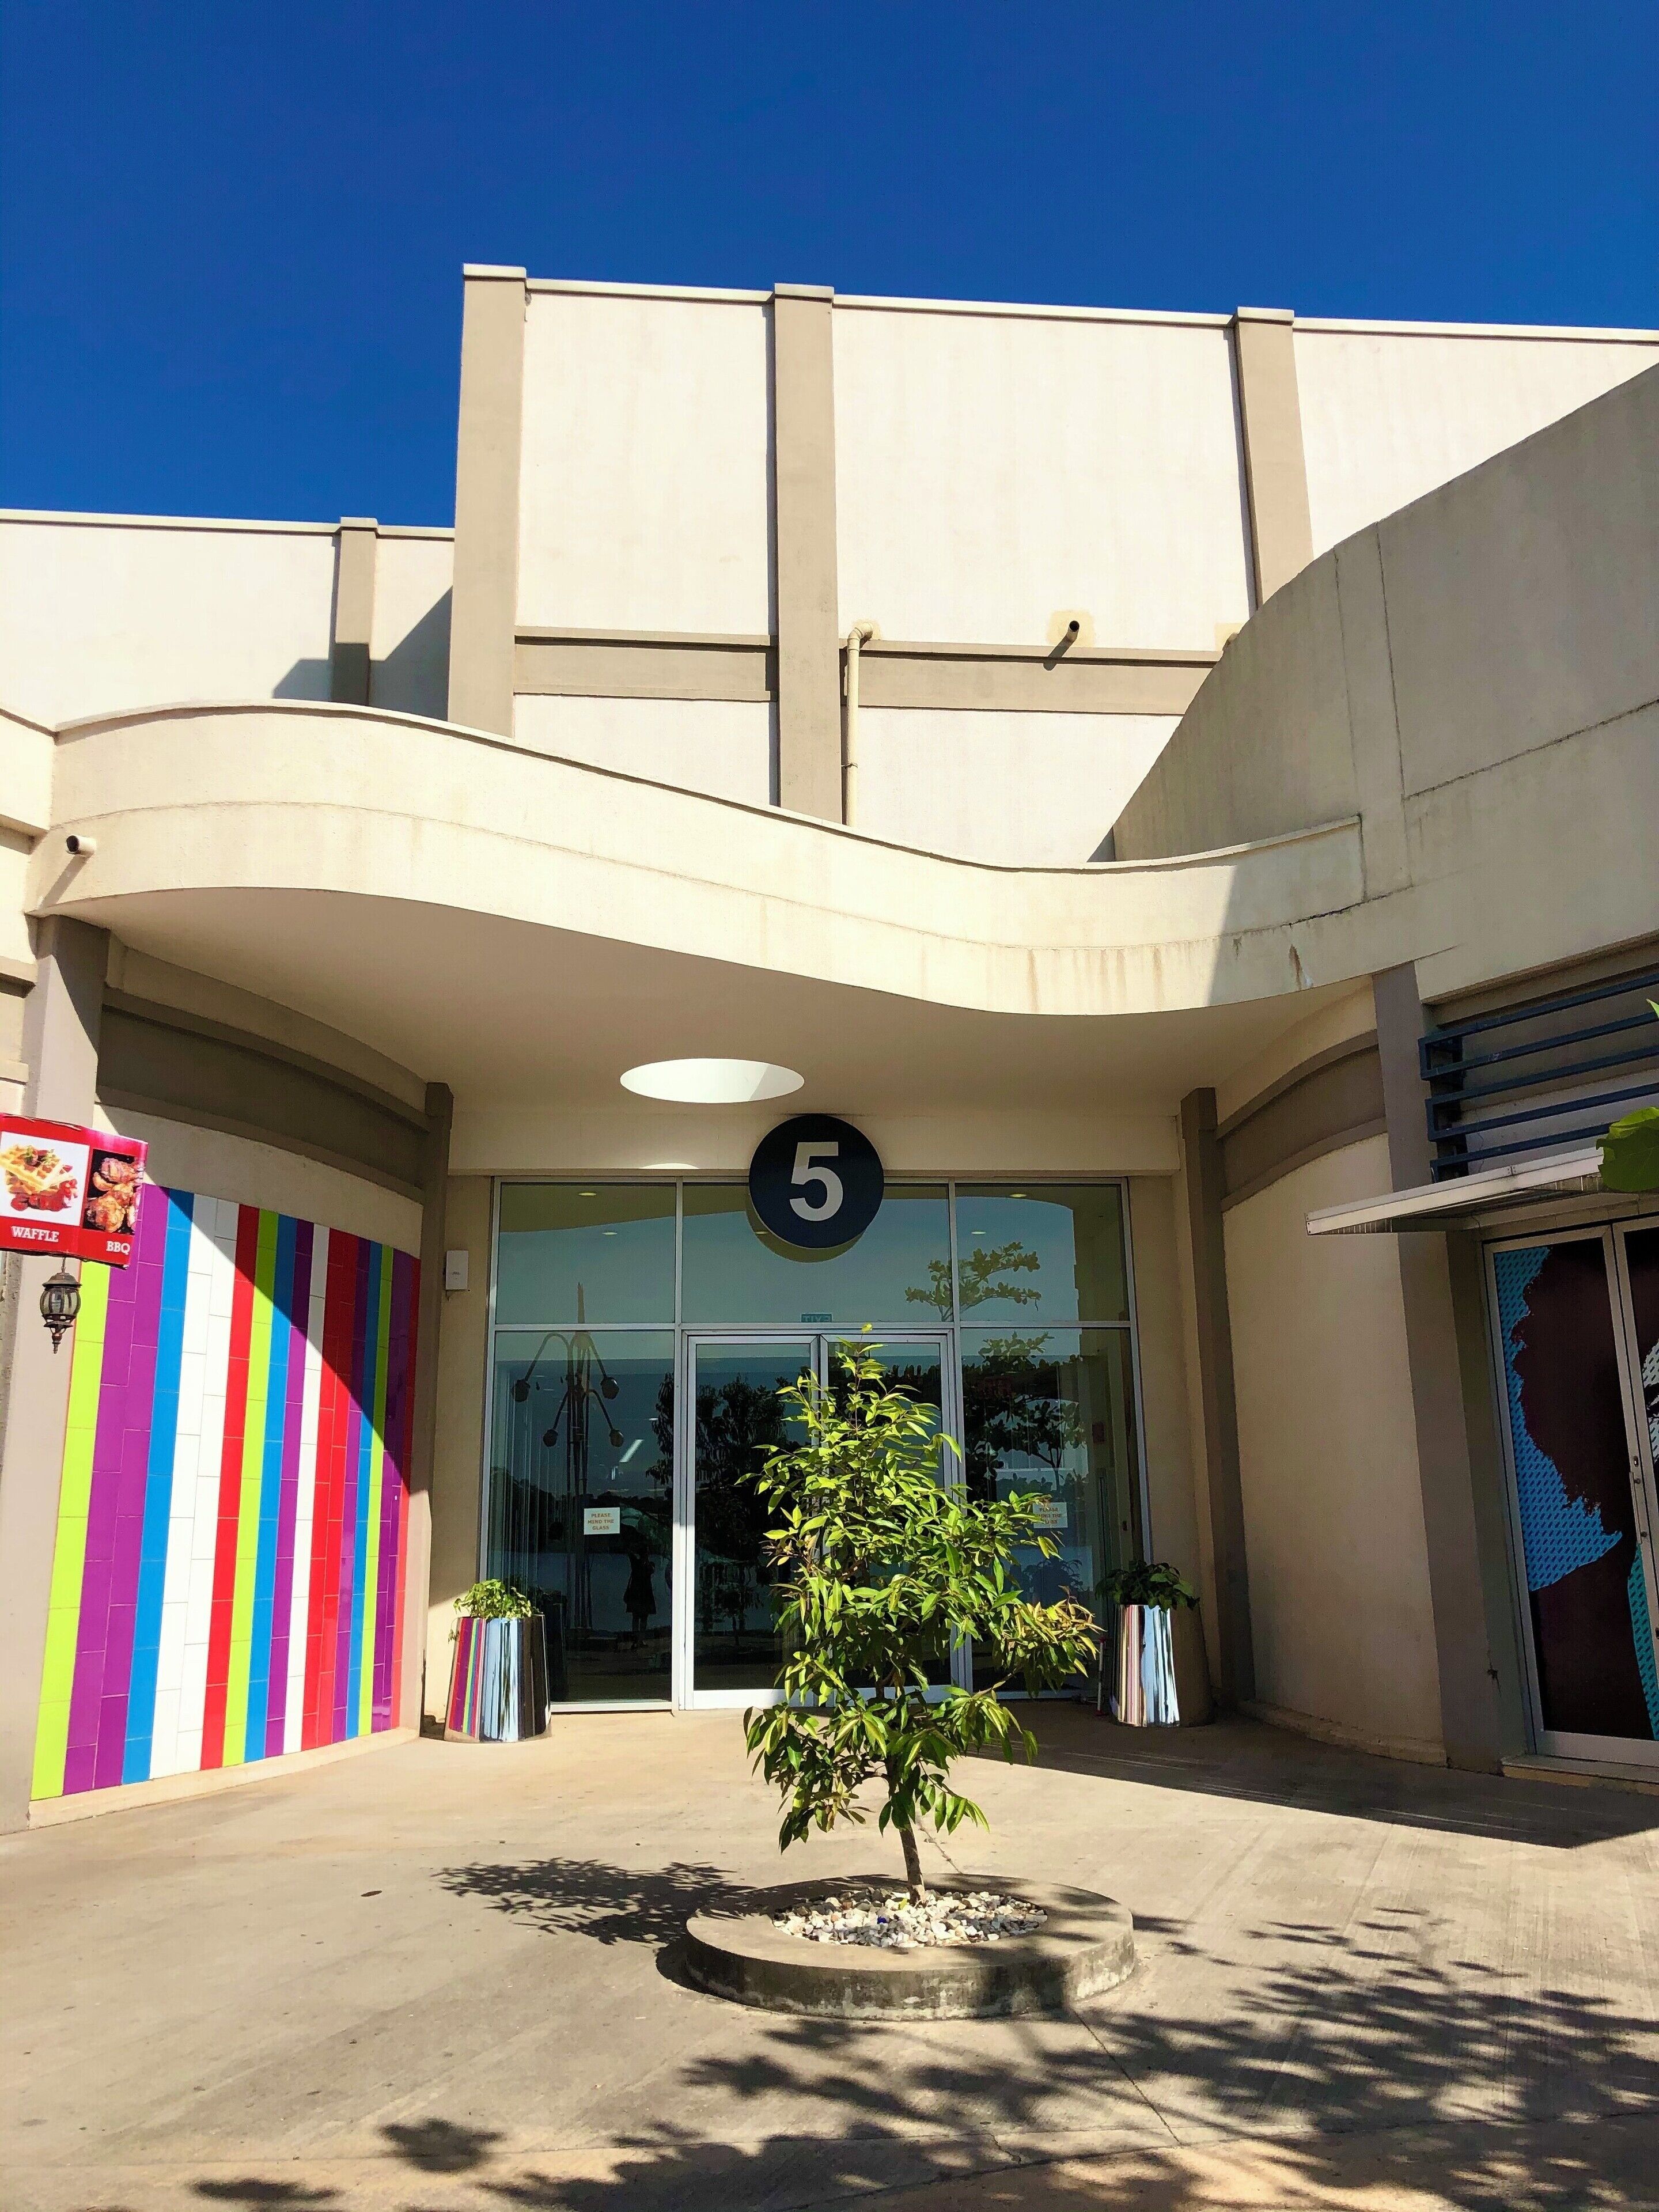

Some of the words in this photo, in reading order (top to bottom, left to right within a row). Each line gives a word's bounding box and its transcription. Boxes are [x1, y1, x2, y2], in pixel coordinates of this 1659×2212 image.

[789, 1141, 843, 1221] 5
[11, 1226, 60, 1243] WAFFLE
[105, 1240, 131, 1255] BBQ
